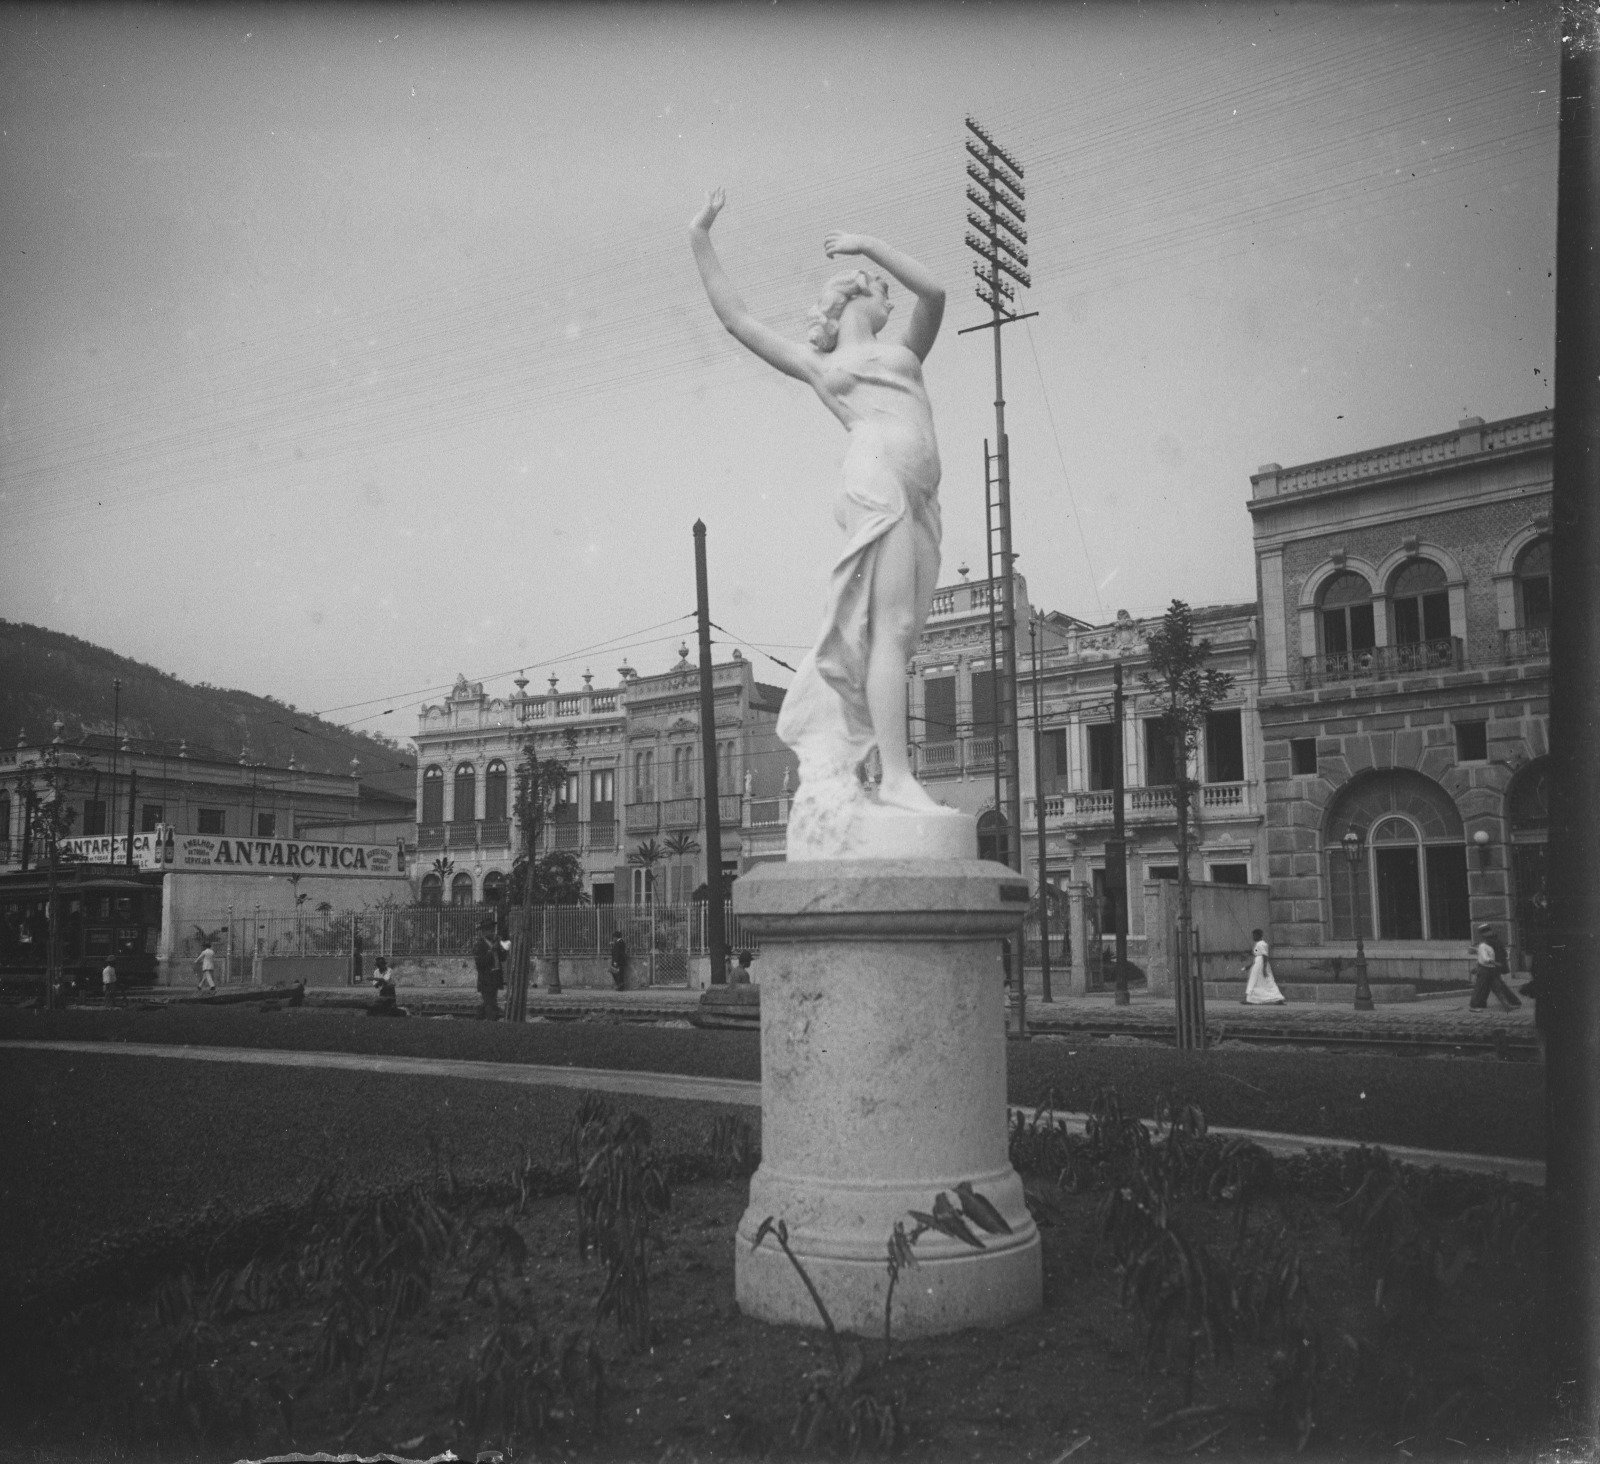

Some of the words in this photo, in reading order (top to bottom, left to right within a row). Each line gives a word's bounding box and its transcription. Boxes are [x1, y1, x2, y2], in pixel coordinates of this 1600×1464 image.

[66, 836, 149, 854] ANTARCTCA
[187, 839, 215, 852] MELHOR
[184, 856, 211, 865] CERVEJAS
[214, 840, 367, 868] ANTARCTICA
